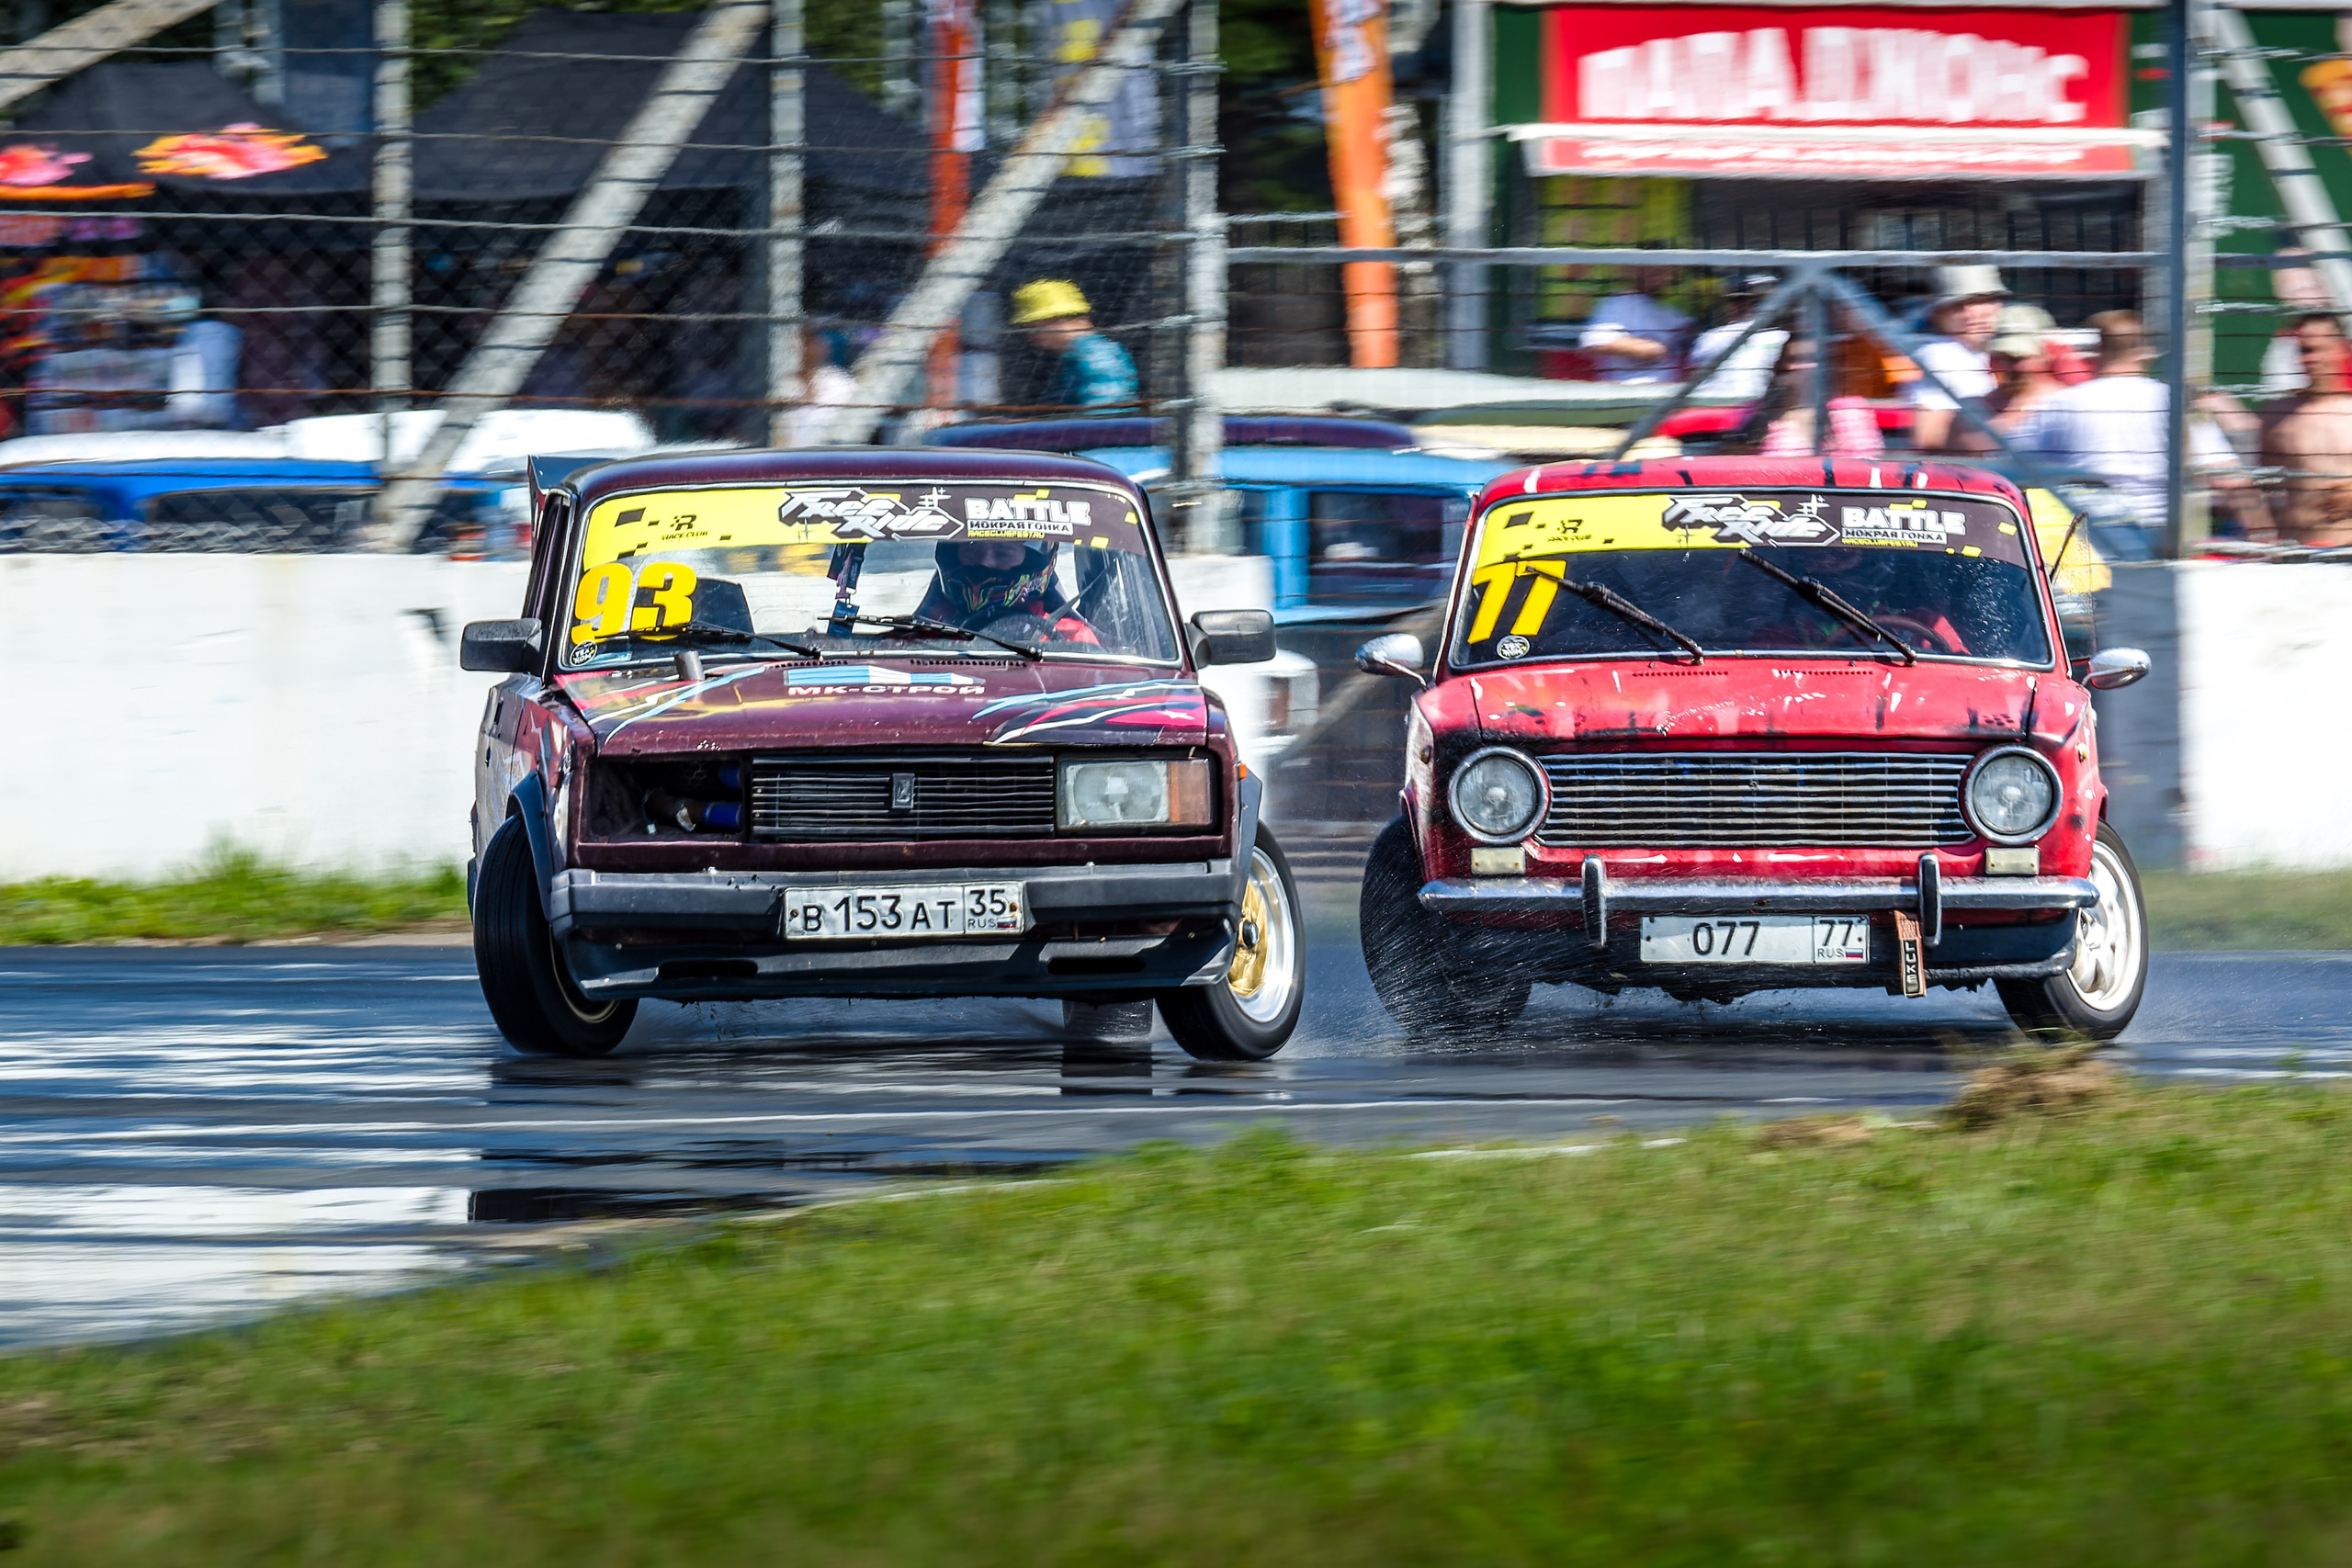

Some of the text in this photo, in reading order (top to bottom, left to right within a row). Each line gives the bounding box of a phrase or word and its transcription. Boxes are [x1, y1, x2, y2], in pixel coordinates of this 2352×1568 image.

[965, 497, 1091, 526] BATTLE
[1841, 506, 1966, 536] BATTLE
[969, 520, 1069, 532] МОКРАЯ ГОНКА
[1845, 528, 1944, 541] МОКРАЯ ГОНКА
[571, 561, 697, 646] 93
[787, 684, 986, 696] МК-СТРОЙ
[969, 888, 1009, 917] 35
[967, 918, 997, 929] RUS
[1819, 919, 1854, 947] 77
[1693, 920, 1760, 956] 077
[1817, 948, 1845, 958] RUS
